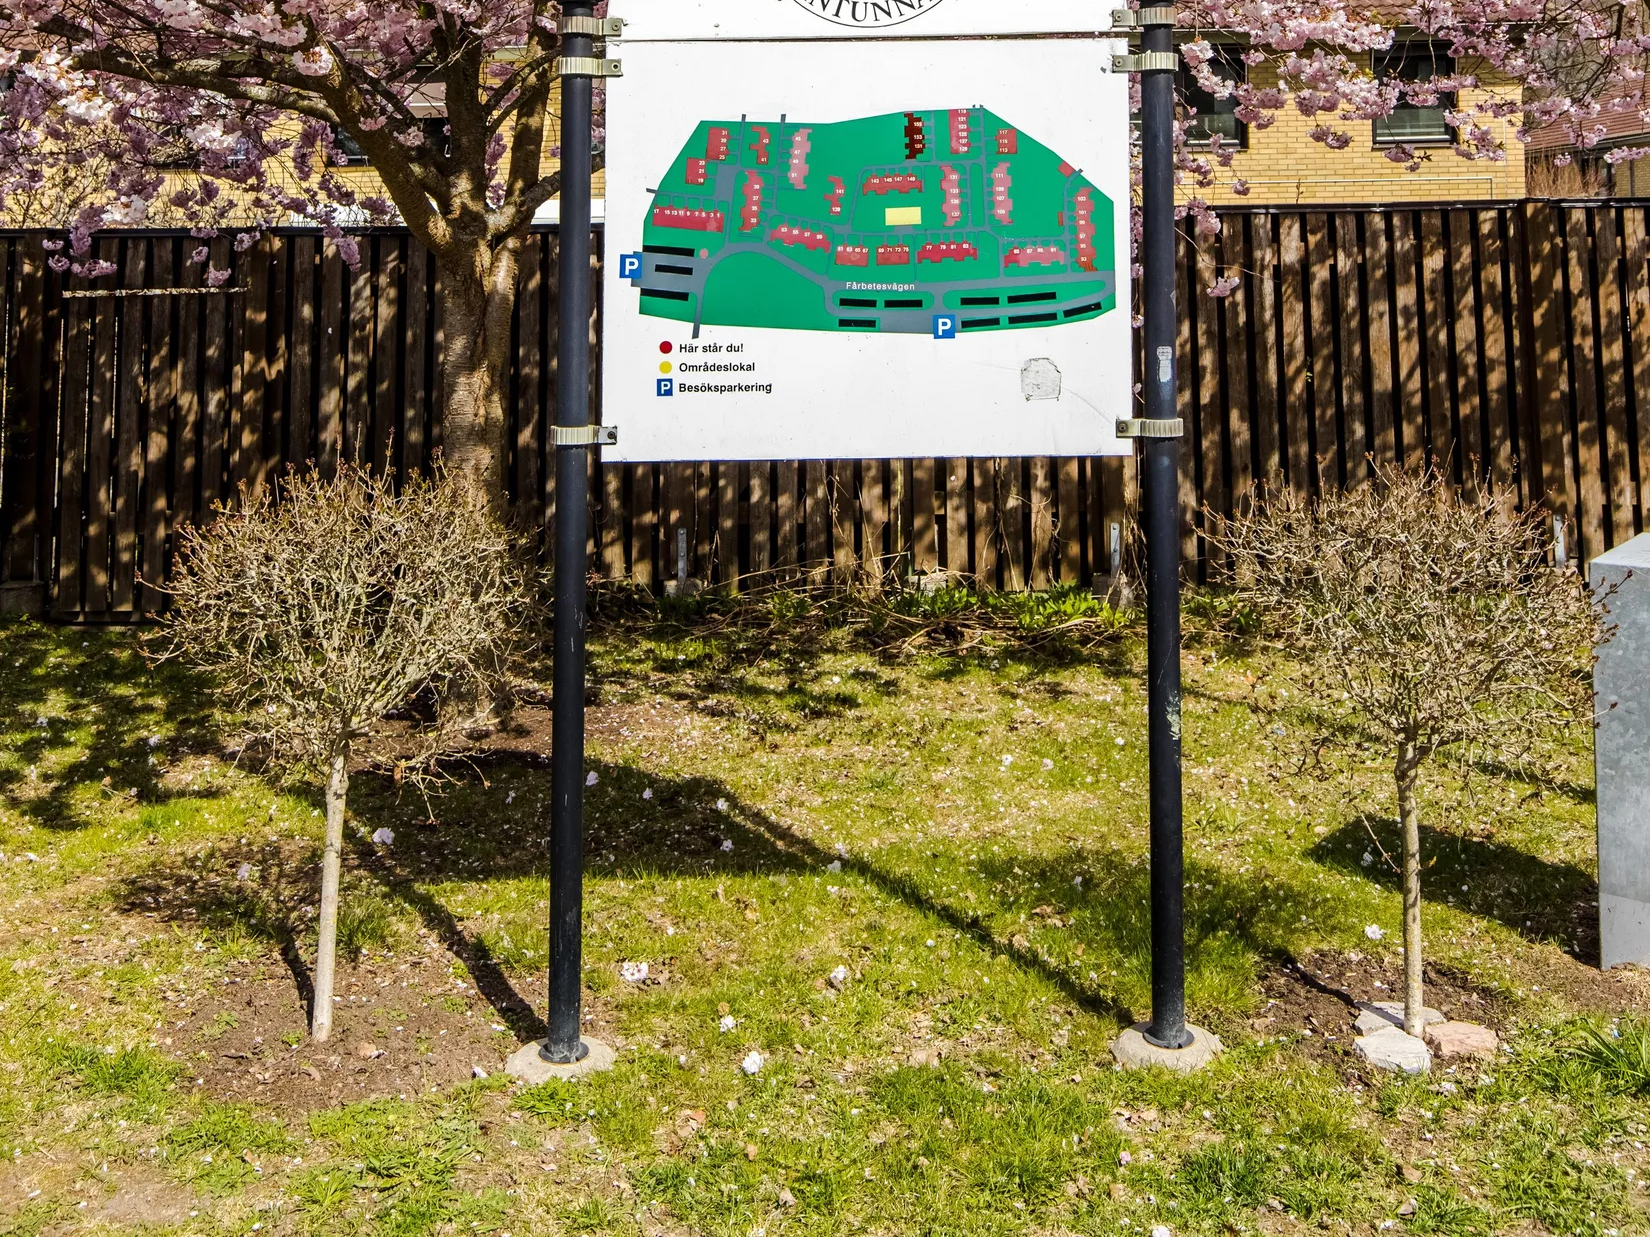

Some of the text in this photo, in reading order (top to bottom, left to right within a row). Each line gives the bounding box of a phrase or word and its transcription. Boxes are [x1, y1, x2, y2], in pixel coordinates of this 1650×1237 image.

[625, 258, 639, 275] P
[846, 282, 915, 291] Fårbetesvägen
[937, 318, 951, 336] P
[679, 342, 744, 353] Här står du!
[679, 361, 755, 372] Områdeslokal
[661, 381, 671, 394] P
[679, 382, 772, 394] Besöksparkering
